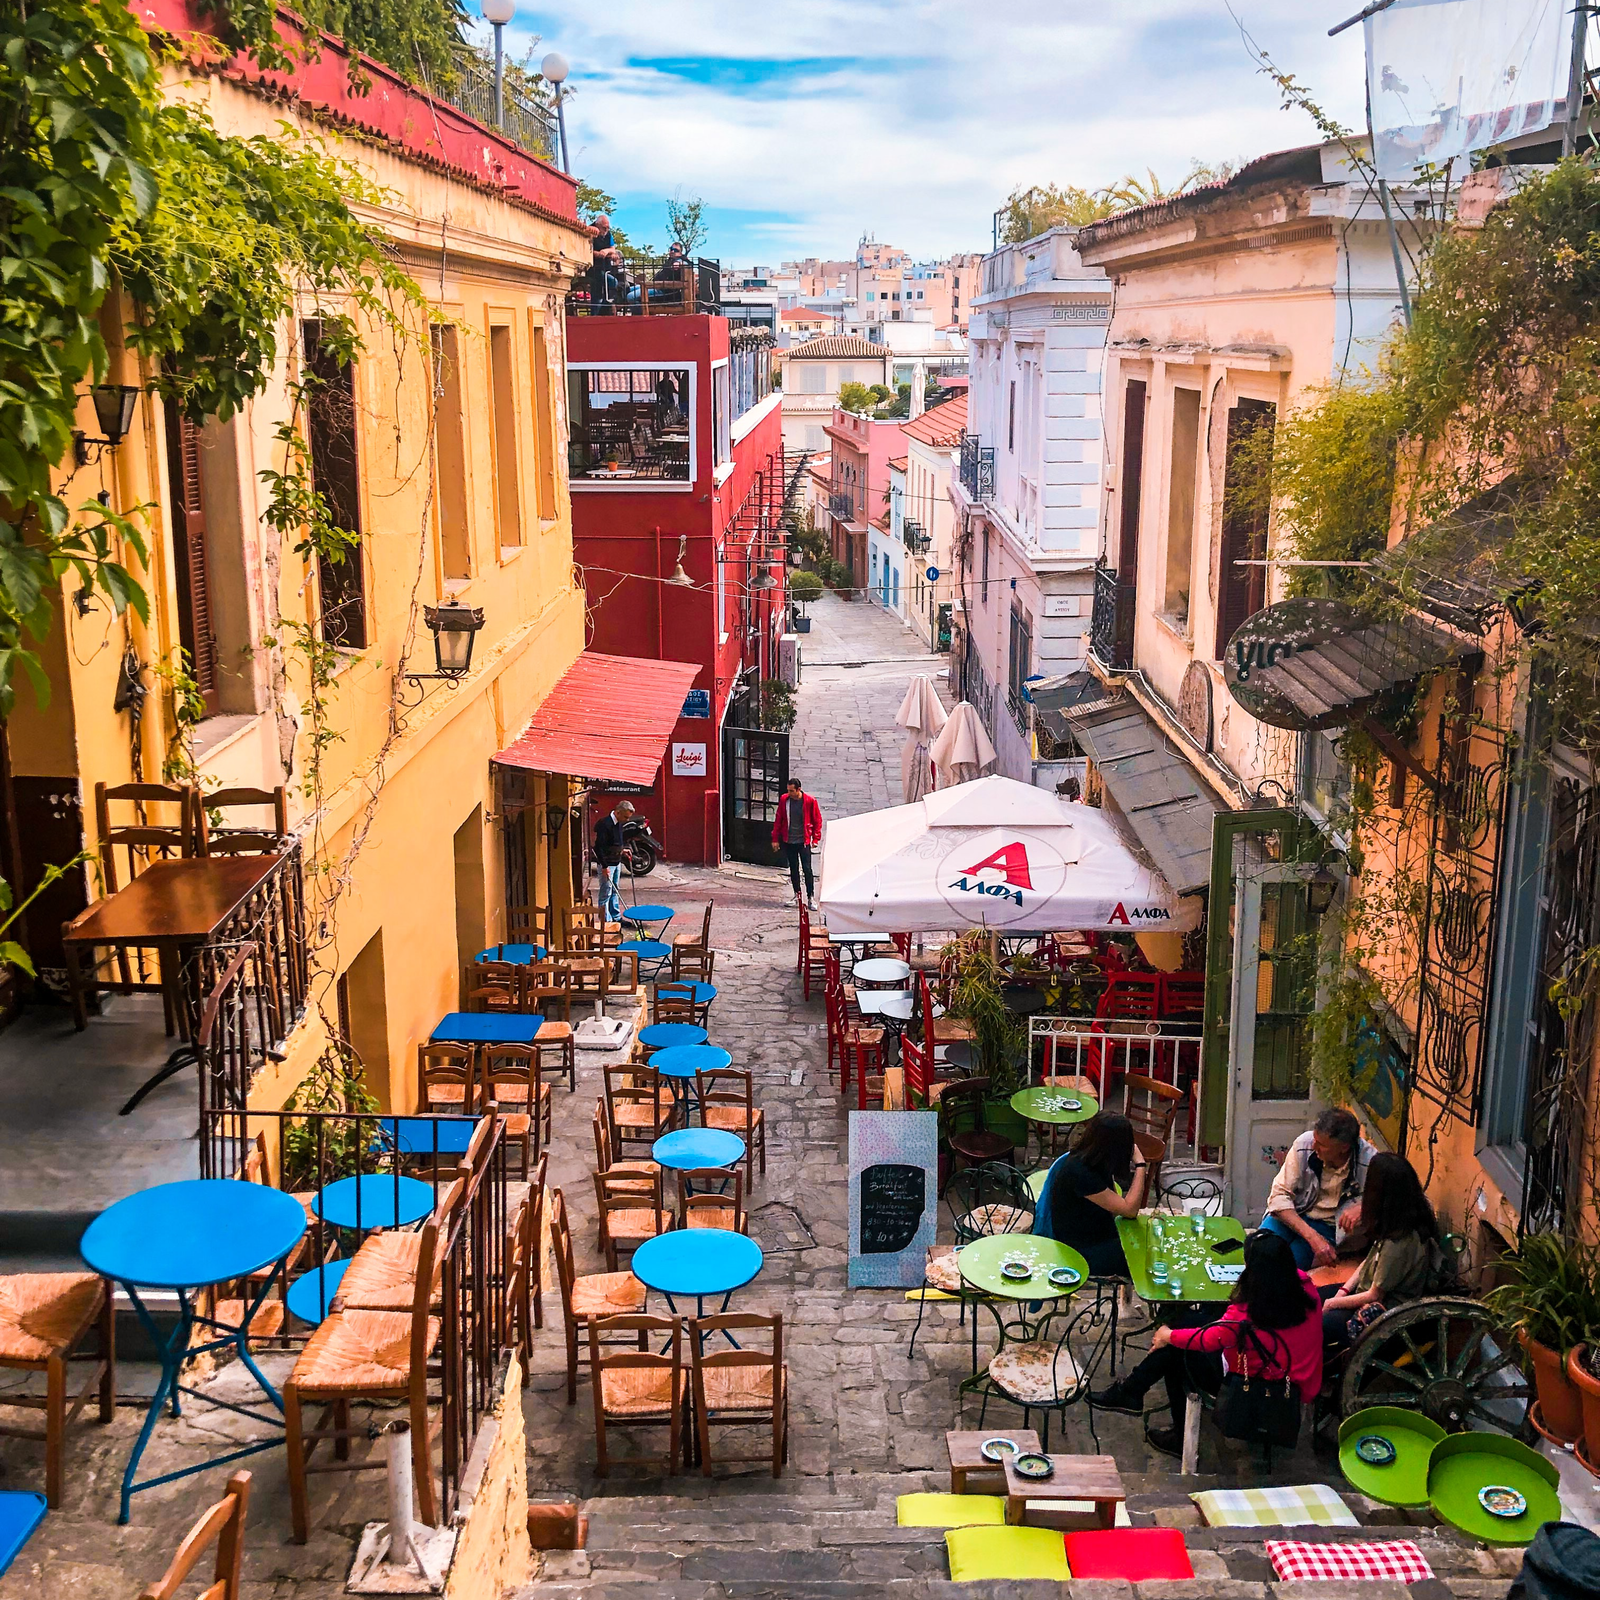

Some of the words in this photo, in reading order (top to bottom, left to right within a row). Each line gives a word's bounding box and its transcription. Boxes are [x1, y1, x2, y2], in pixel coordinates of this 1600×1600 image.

[675, 747, 703, 767] Luigi
[948, 877, 1023, 907] ΑΛΦΑ
[1131, 907, 1171, 919] ΑΛΦΑ
[876, 1231, 887, 1242] 10
